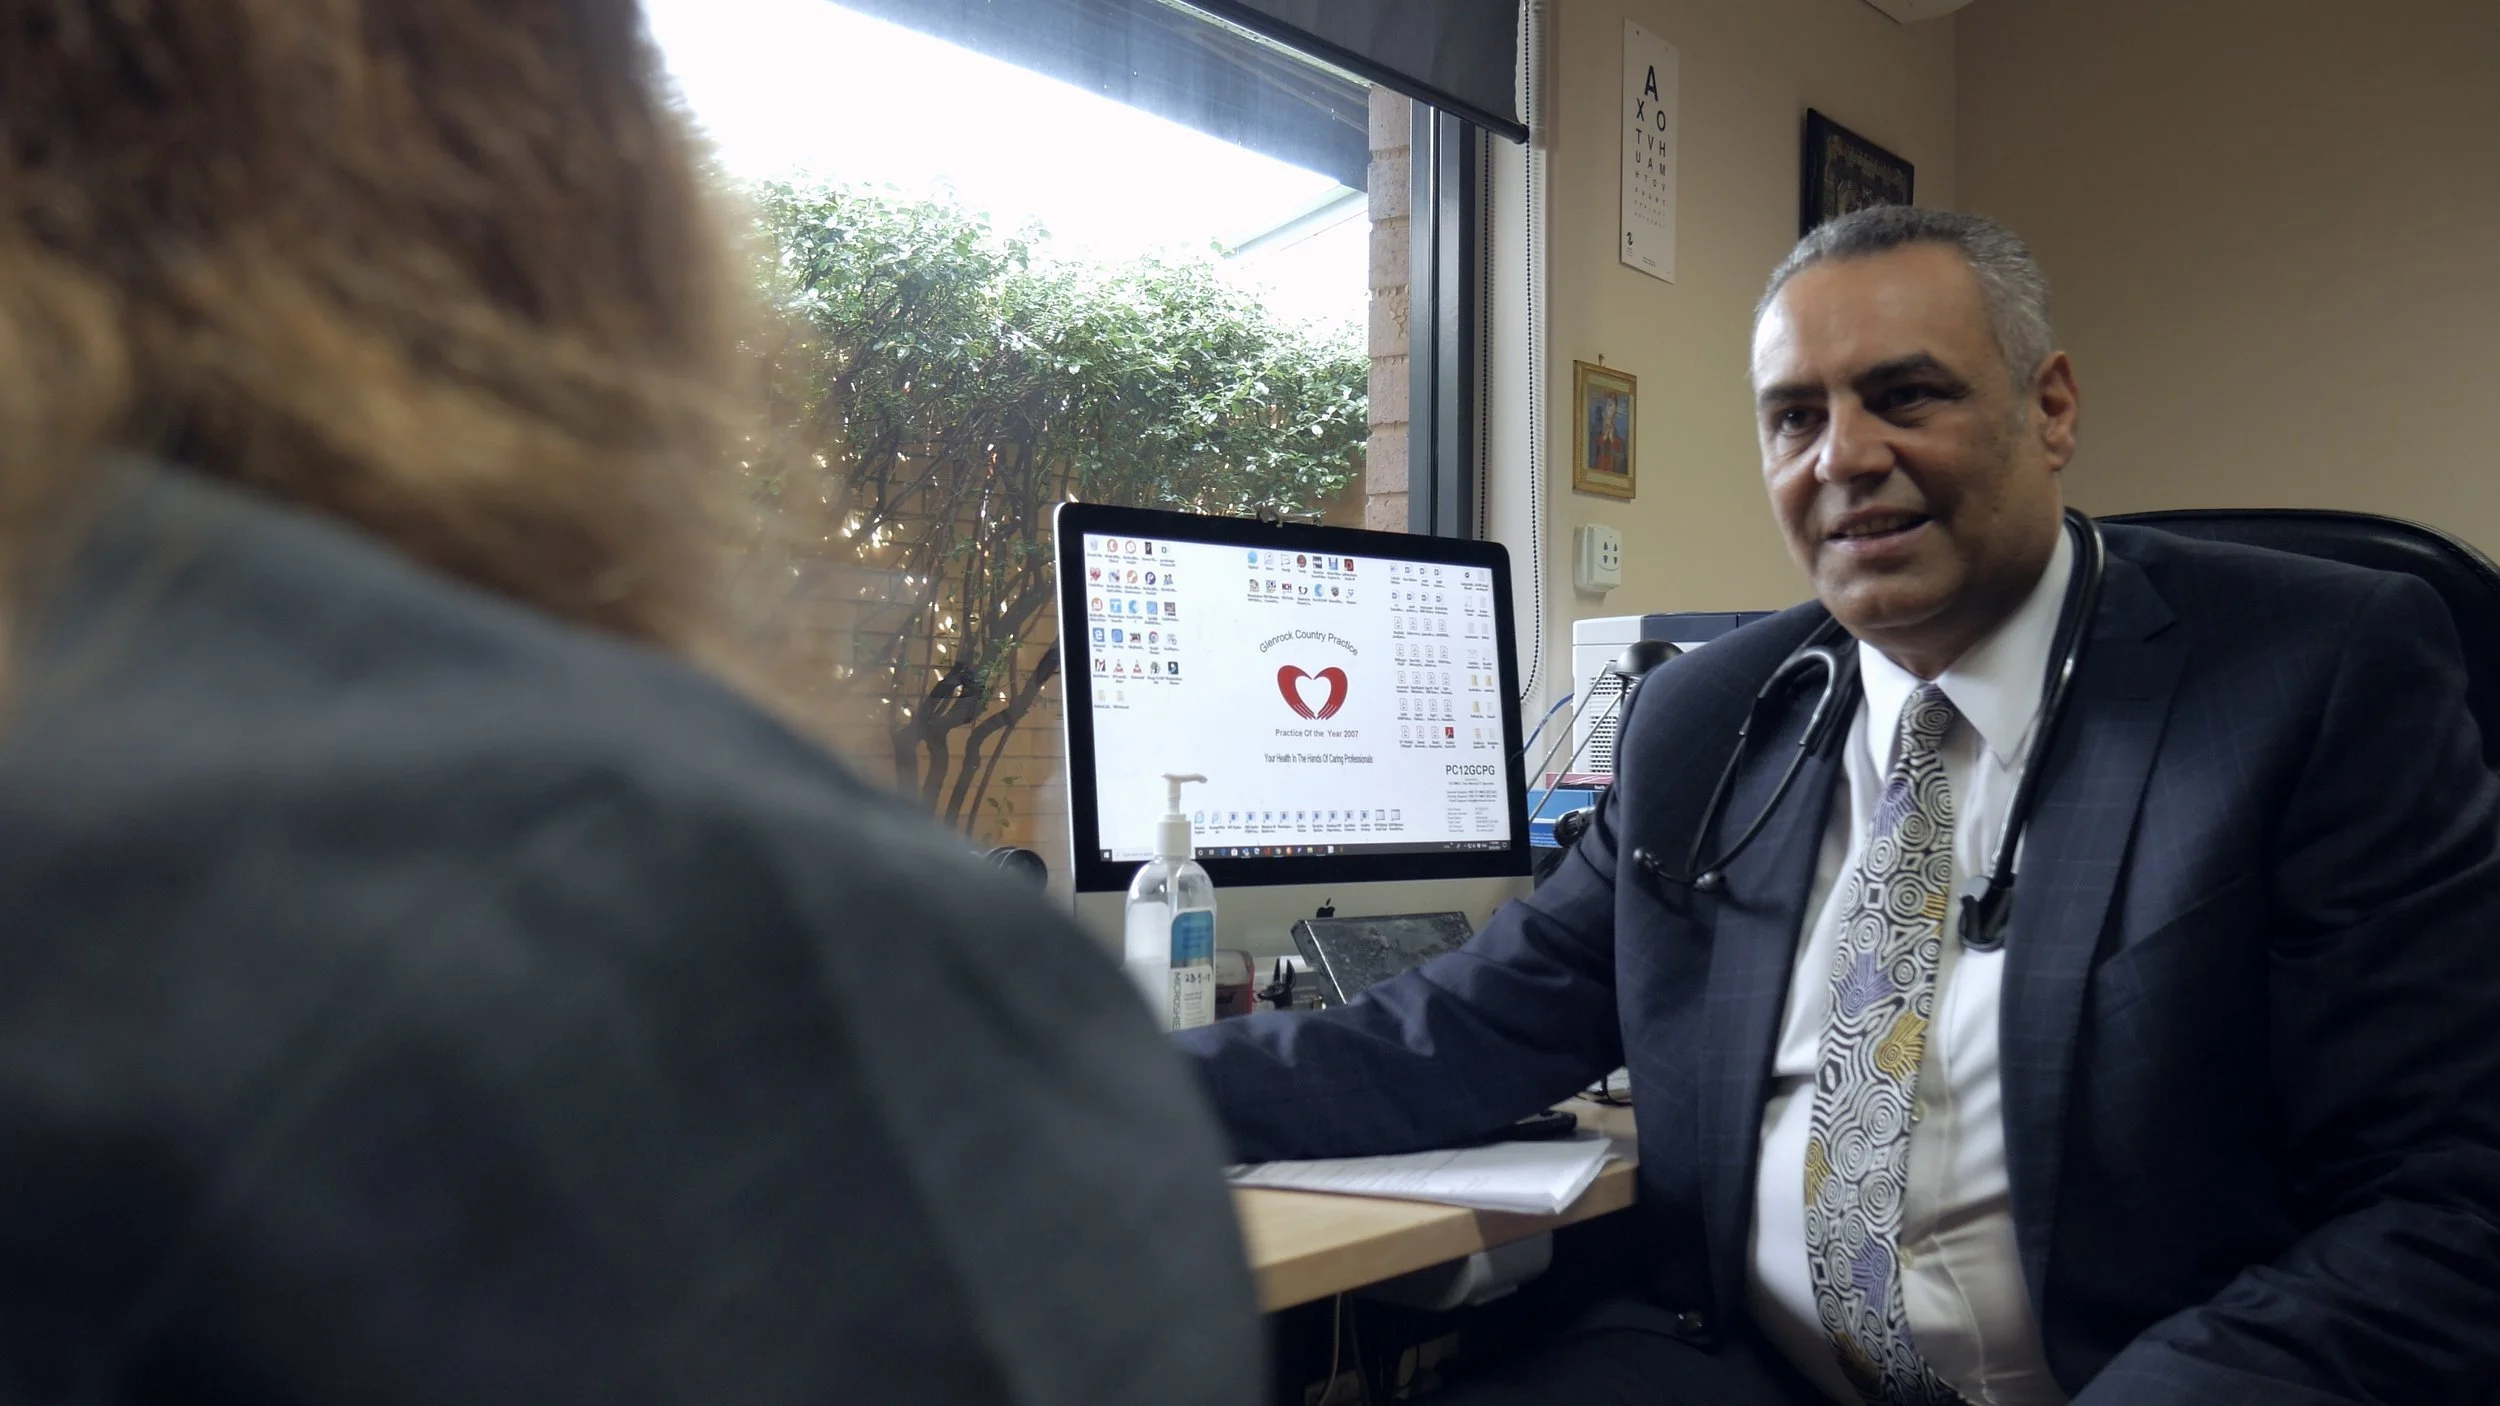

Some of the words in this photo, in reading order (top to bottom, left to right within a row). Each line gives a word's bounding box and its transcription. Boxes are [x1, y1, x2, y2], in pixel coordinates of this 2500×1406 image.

[1644, 65, 1659, 102] A
[1636, 98, 1645, 122] X
[1656, 110, 1666, 132] O
[1635, 128, 1642, 145] T
[1647, 134, 1654, 151] V
[1659, 140, 1666, 158] H
[1635, 150, 1641, 164] U
[1647, 157, 1653, 170] A
[1659, 162, 1666, 177] M
[1259, 630, 1294, 654] Glenrock
[1294, 629, 1327, 643] Country
[1327, 632, 1358, 656] Practice
[1275, 728, 1303, 737] Practice
[1303, 729, 1312, 737] Of
[1313, 729, 1324, 738] the
[1327, 729, 1342, 738] Year
[1343, 730, 1359, 738] 2007
[1264, 753, 1276, 763] Your
[1276, 753, 1291, 763] Health
[1292, 753, 1297, 763] In
[1297, 753, 1306, 763] The
[1307, 753, 1322, 763] Hands
[1322, 753, 1328, 763] Of
[1329, 753, 1344, 766] Caring
[1344, 754, 1374, 764] Professionals
[1445, 765, 1495, 775] PC12GCPG
